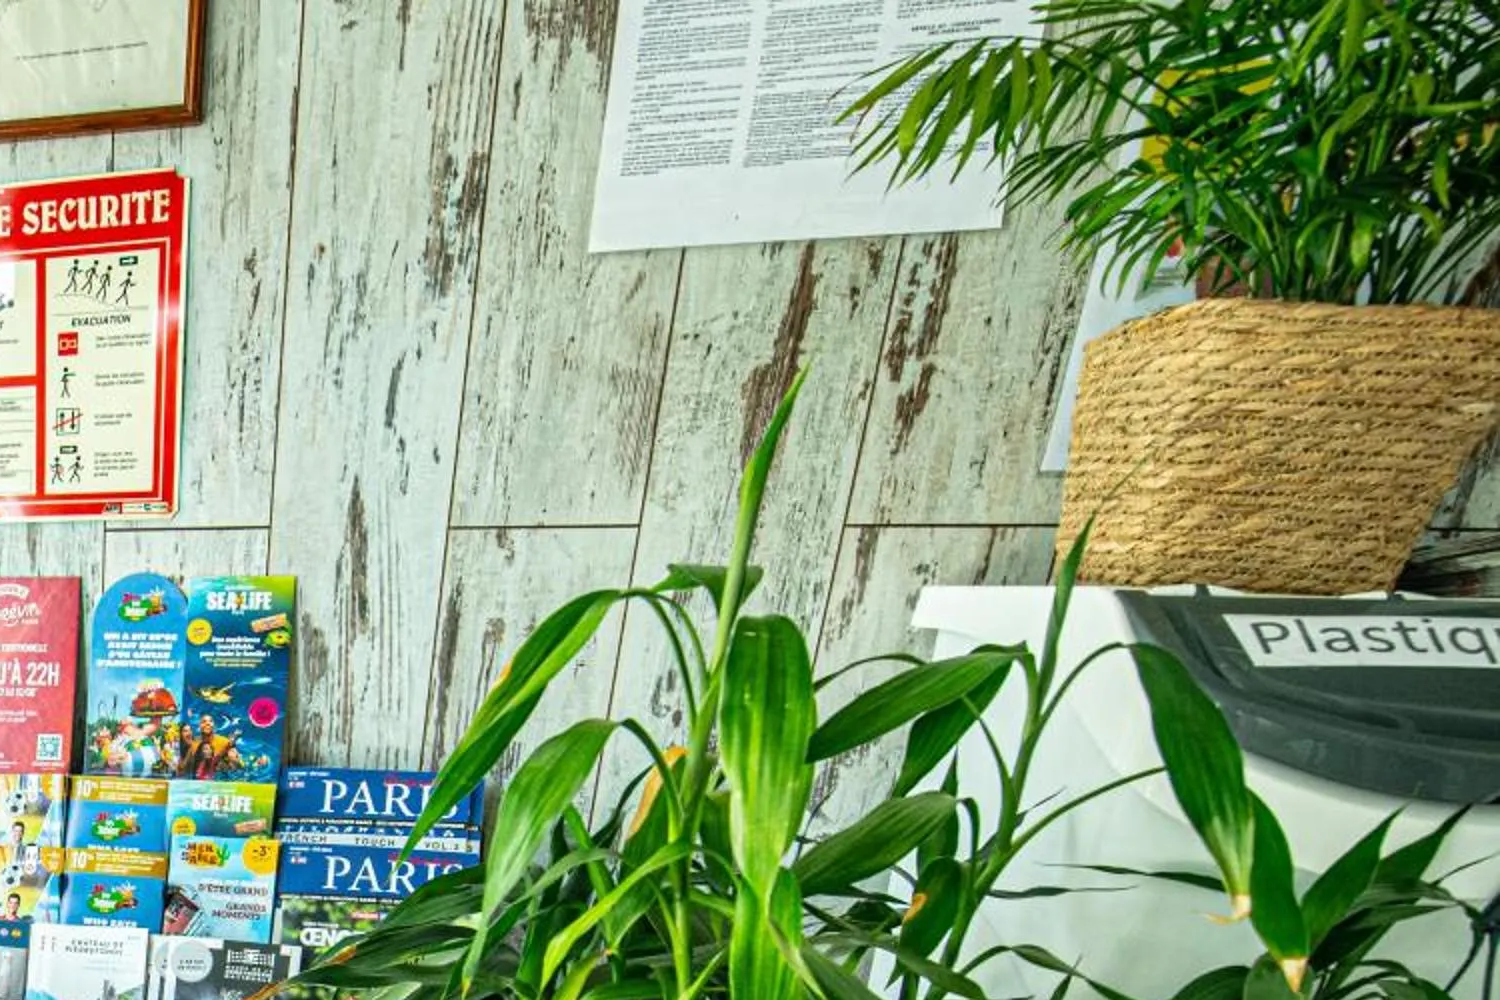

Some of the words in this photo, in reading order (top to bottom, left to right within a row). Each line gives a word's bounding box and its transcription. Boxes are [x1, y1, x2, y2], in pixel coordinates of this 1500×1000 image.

[22, 188, 172, 236] SECURITE
[70, 314, 132, 329] EVACUATION
[206, 591, 235, 610] SEA
[242, 591, 273, 611] LIFE
[1249, 616, 1500, 666] Plastiq
[25, 662, 60, 687] 22H
[225, 797, 253, 813] LIFE
[354, 837, 395, 847] TOUCH
